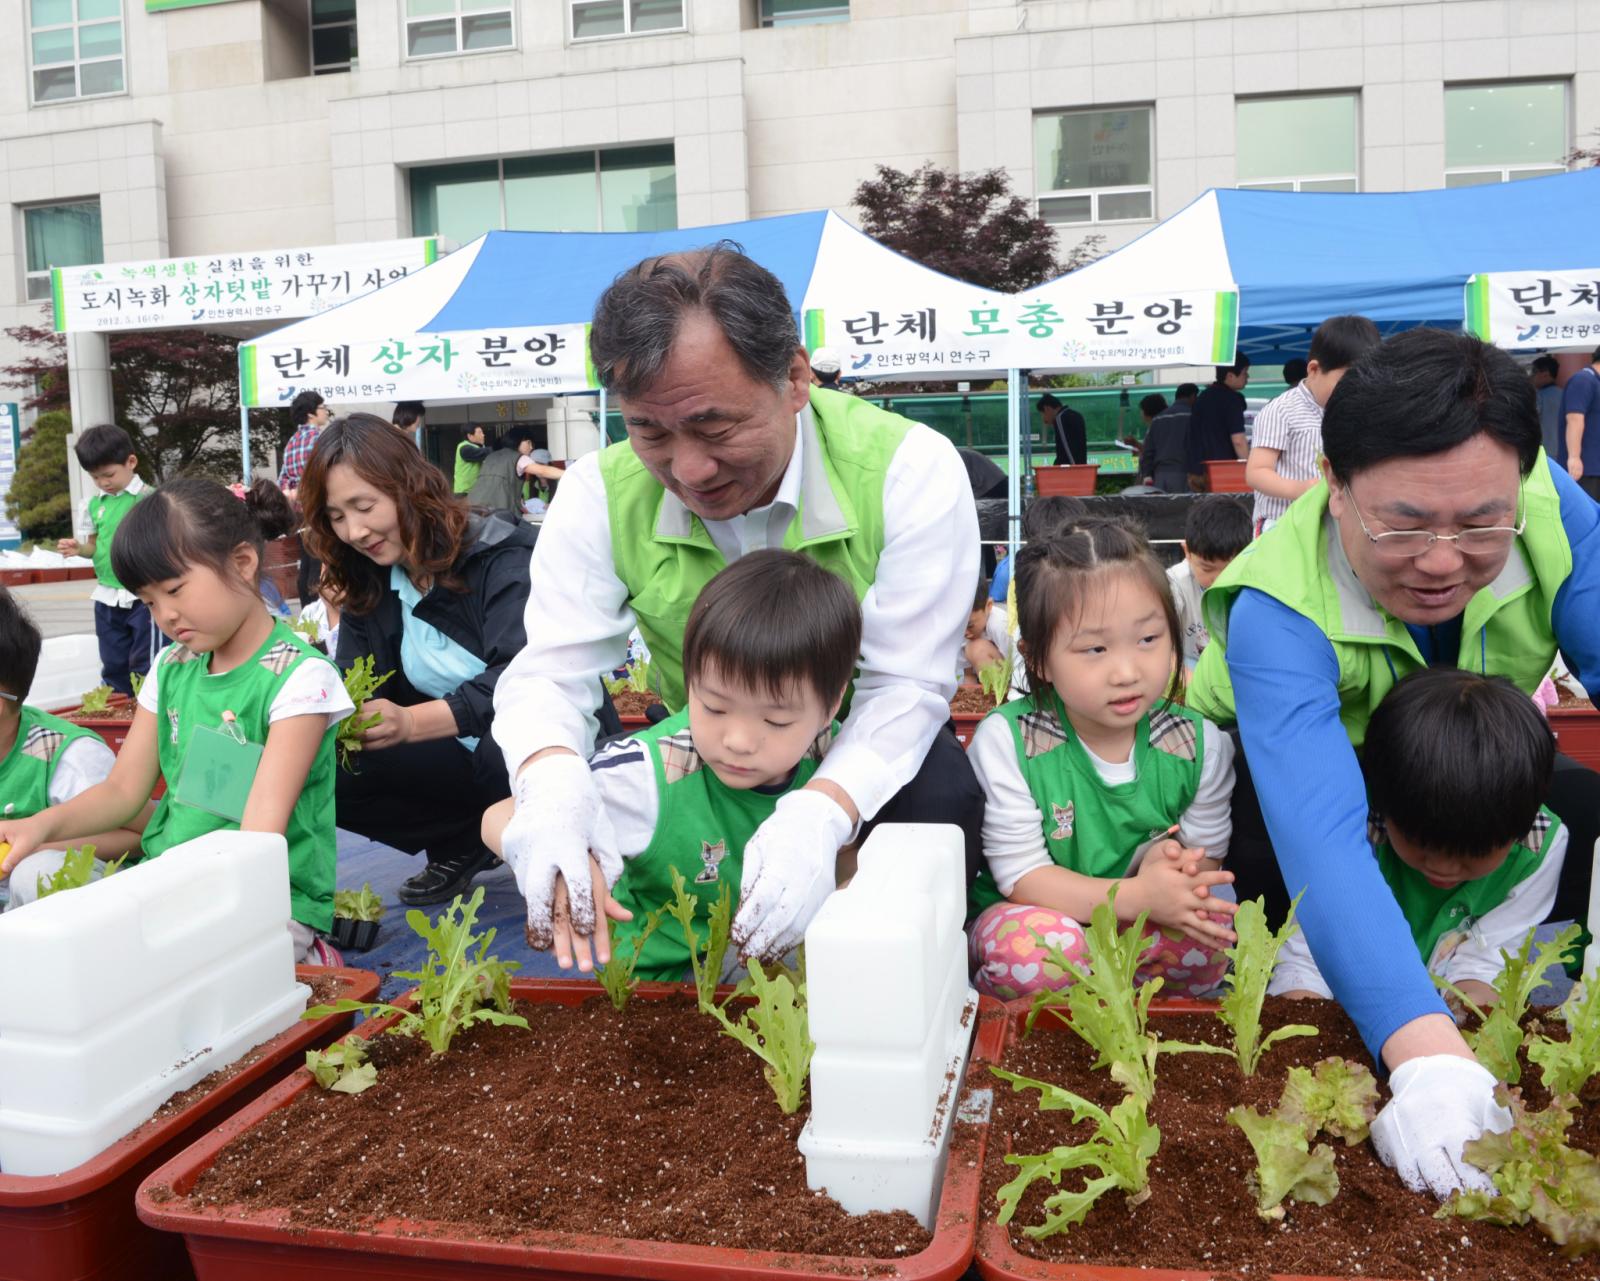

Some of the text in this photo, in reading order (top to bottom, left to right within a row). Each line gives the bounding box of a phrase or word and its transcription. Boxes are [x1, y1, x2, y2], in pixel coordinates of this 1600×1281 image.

[121, 252, 315, 280] 녹색생활 실천을 위한
[80, 284, 171, 311] 도시녹화
[178, 274, 272, 306] 상자텃밭
[281, 270, 351, 298] 가꾸기
[207, 304, 282, 319] 인천광역시 연수구
[841, 298, 1193, 346] 단체 모종 분양
[270, 332, 566, 379] 단체 상자 분양
[877, 350, 991, 367] 인천광역시 연수구
[361, 383, 397, 396] 연수구
